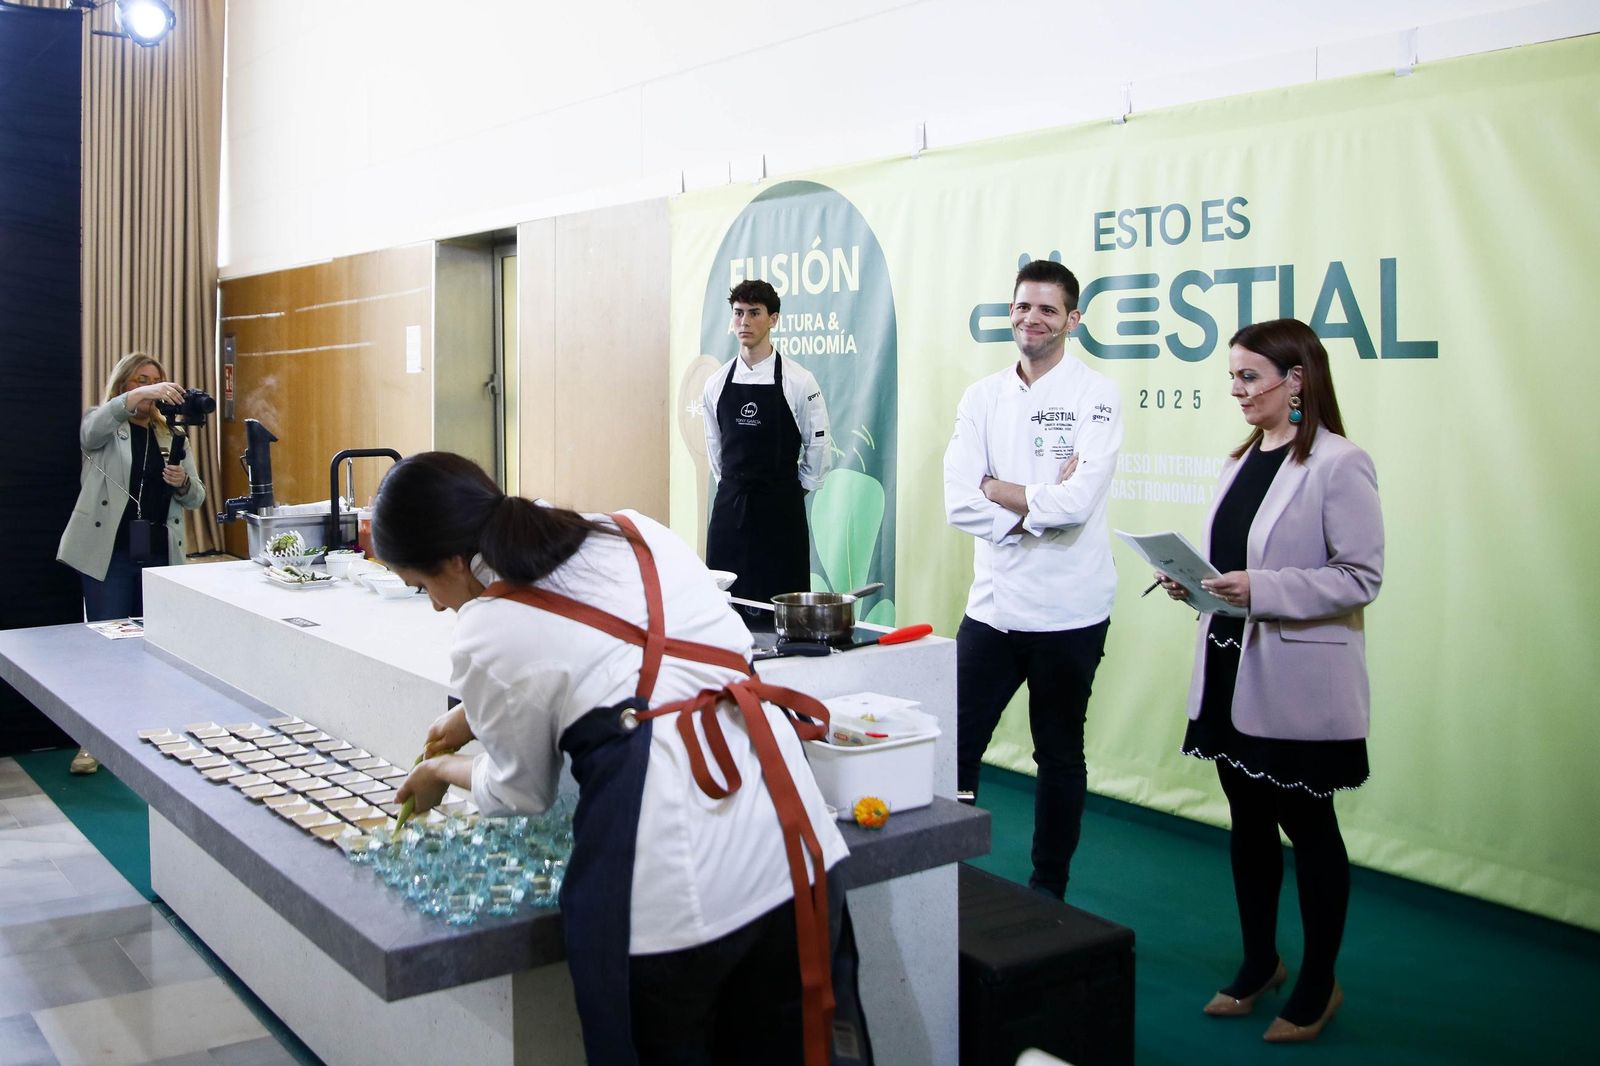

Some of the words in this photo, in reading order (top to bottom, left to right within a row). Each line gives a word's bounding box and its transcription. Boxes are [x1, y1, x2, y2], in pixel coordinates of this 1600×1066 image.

[1093, 203, 1192, 252] ESTO
[1201, 196, 1251, 243] ES
[730, 235, 860, 297] FUSIÓN
[827, 311, 840, 331] &
[770, 329, 858, 356] TRONOMÍA
[1139, 389, 1203, 410] 2025
